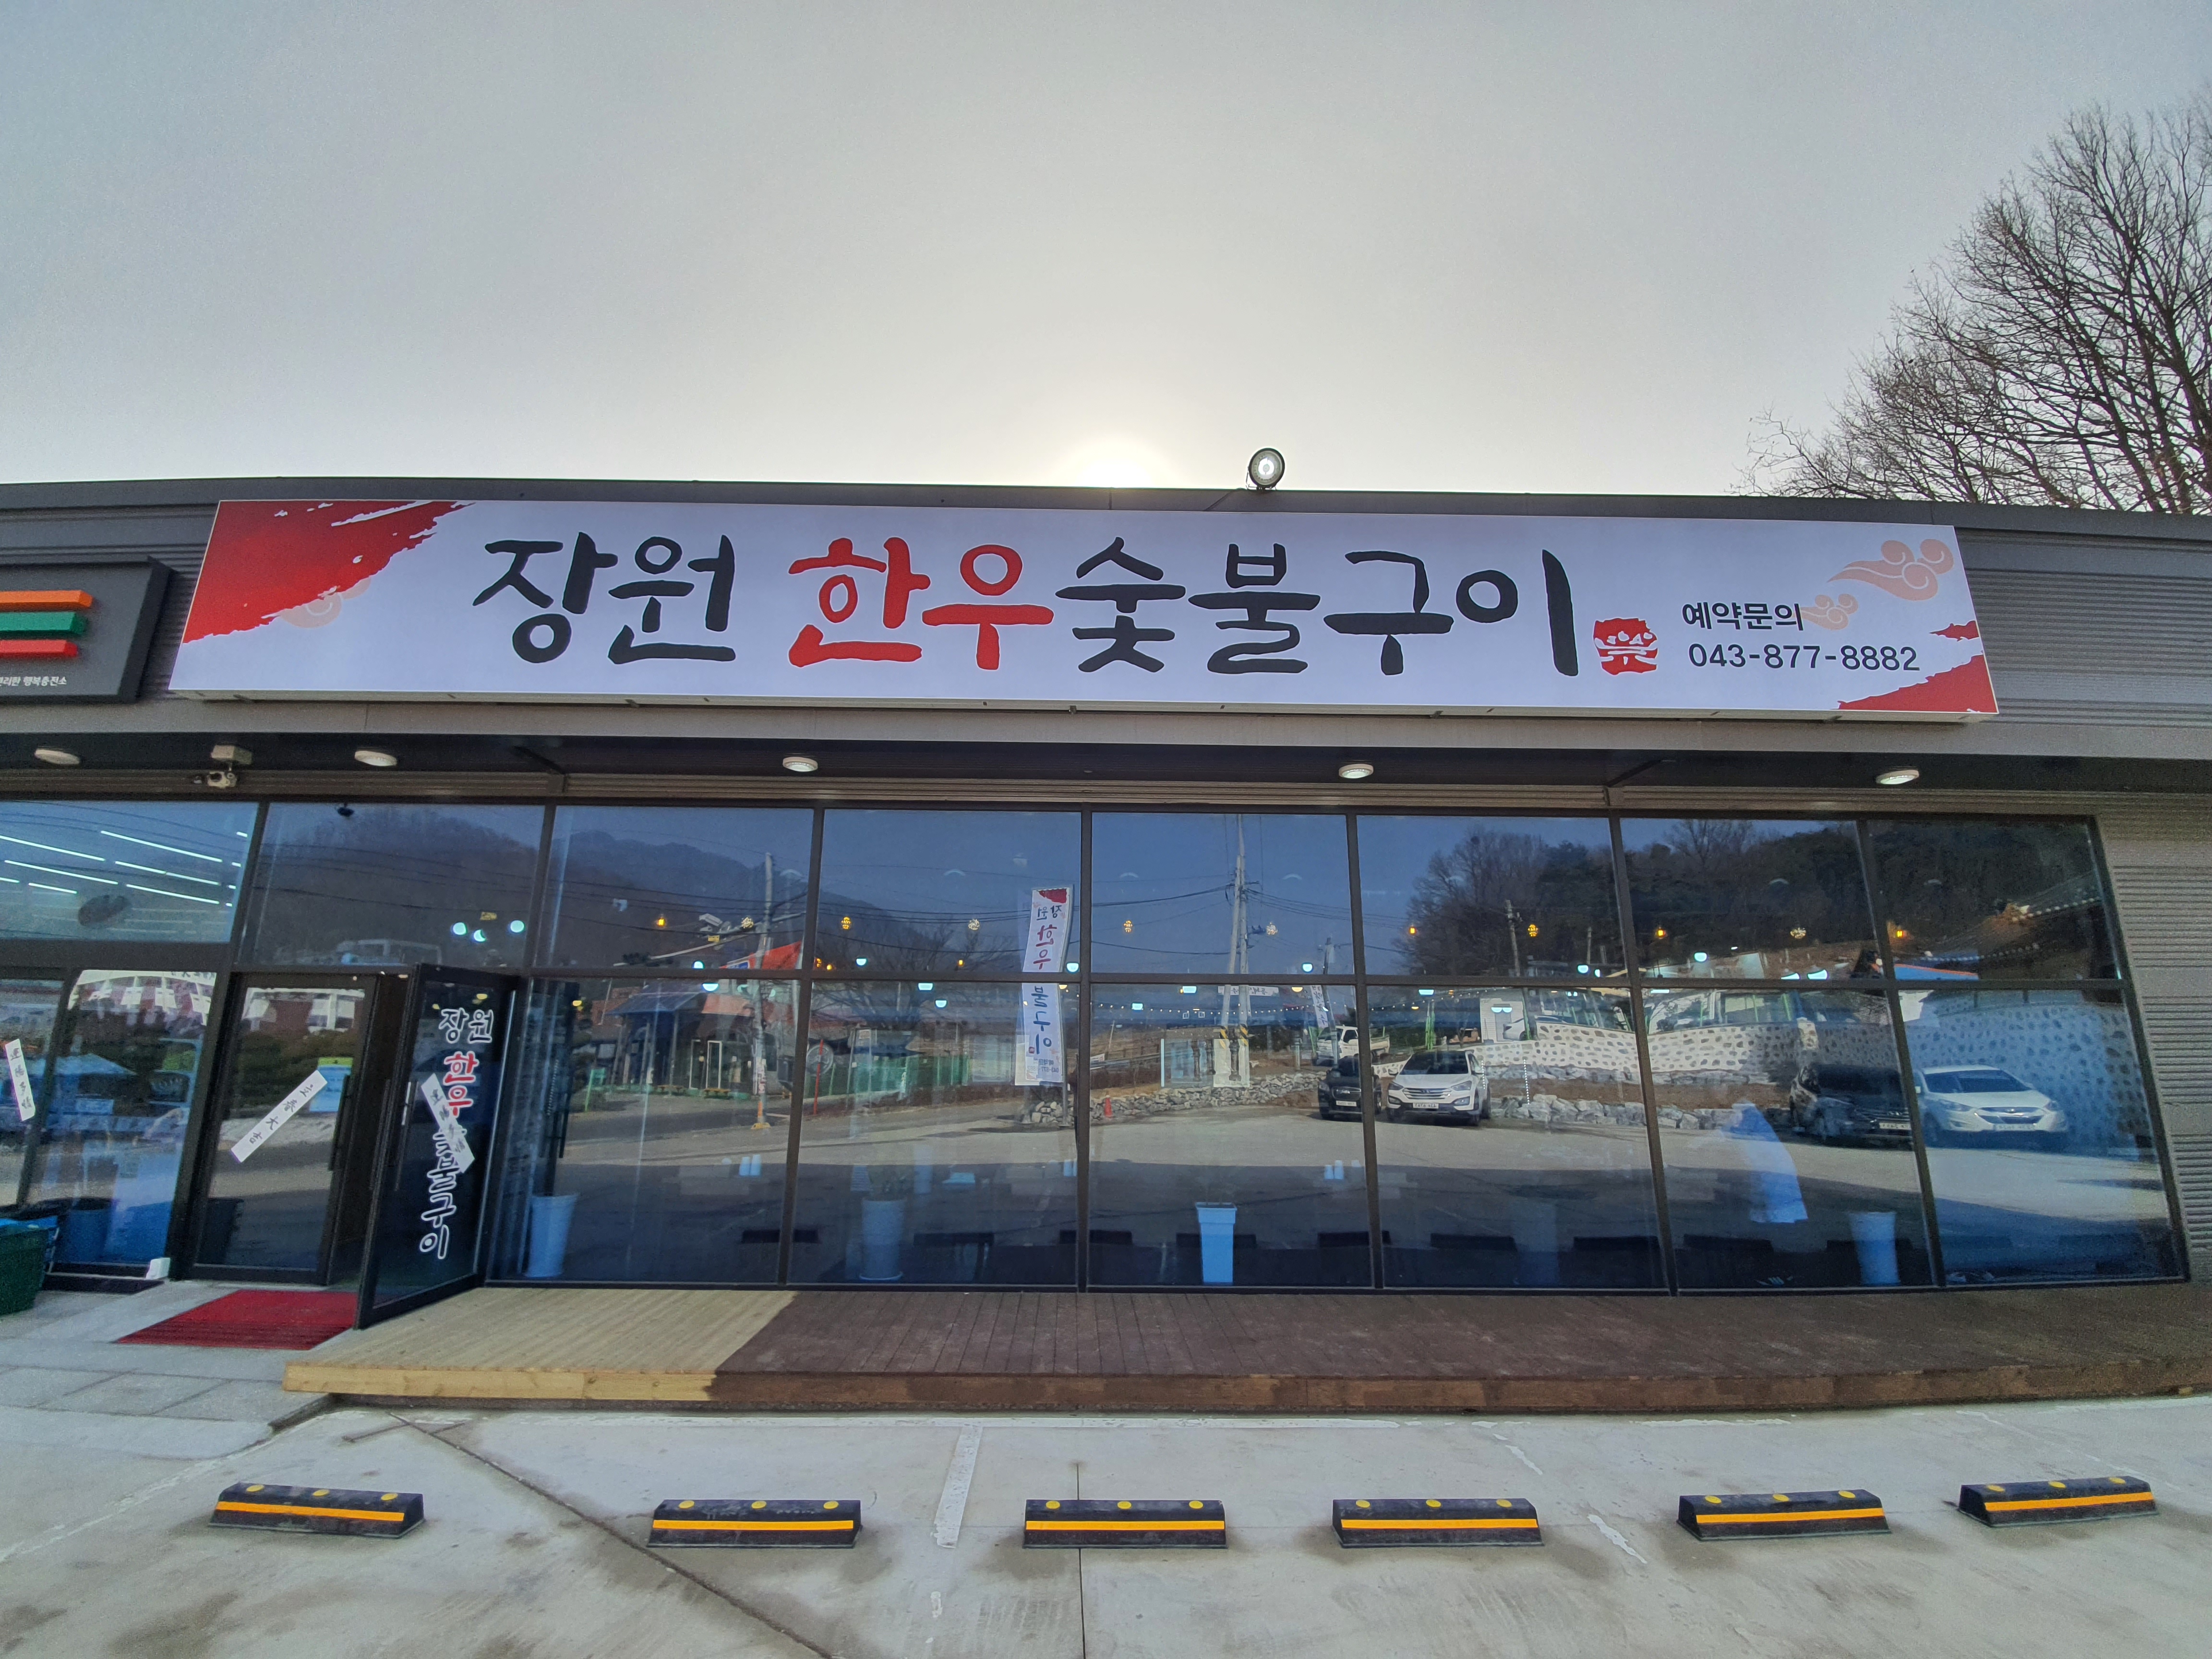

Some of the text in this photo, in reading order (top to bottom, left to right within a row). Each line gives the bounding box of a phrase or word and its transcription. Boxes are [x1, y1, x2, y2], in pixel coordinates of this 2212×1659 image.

[472, 531, 736, 664] 장원
[1682, 602, 1804, 631] 예약문의
[1689, 643, 1920, 672] 043-877-8882
[439, 1008, 494, 1044] 장원
[249, 1083, 314, 1145] 立春大吉
